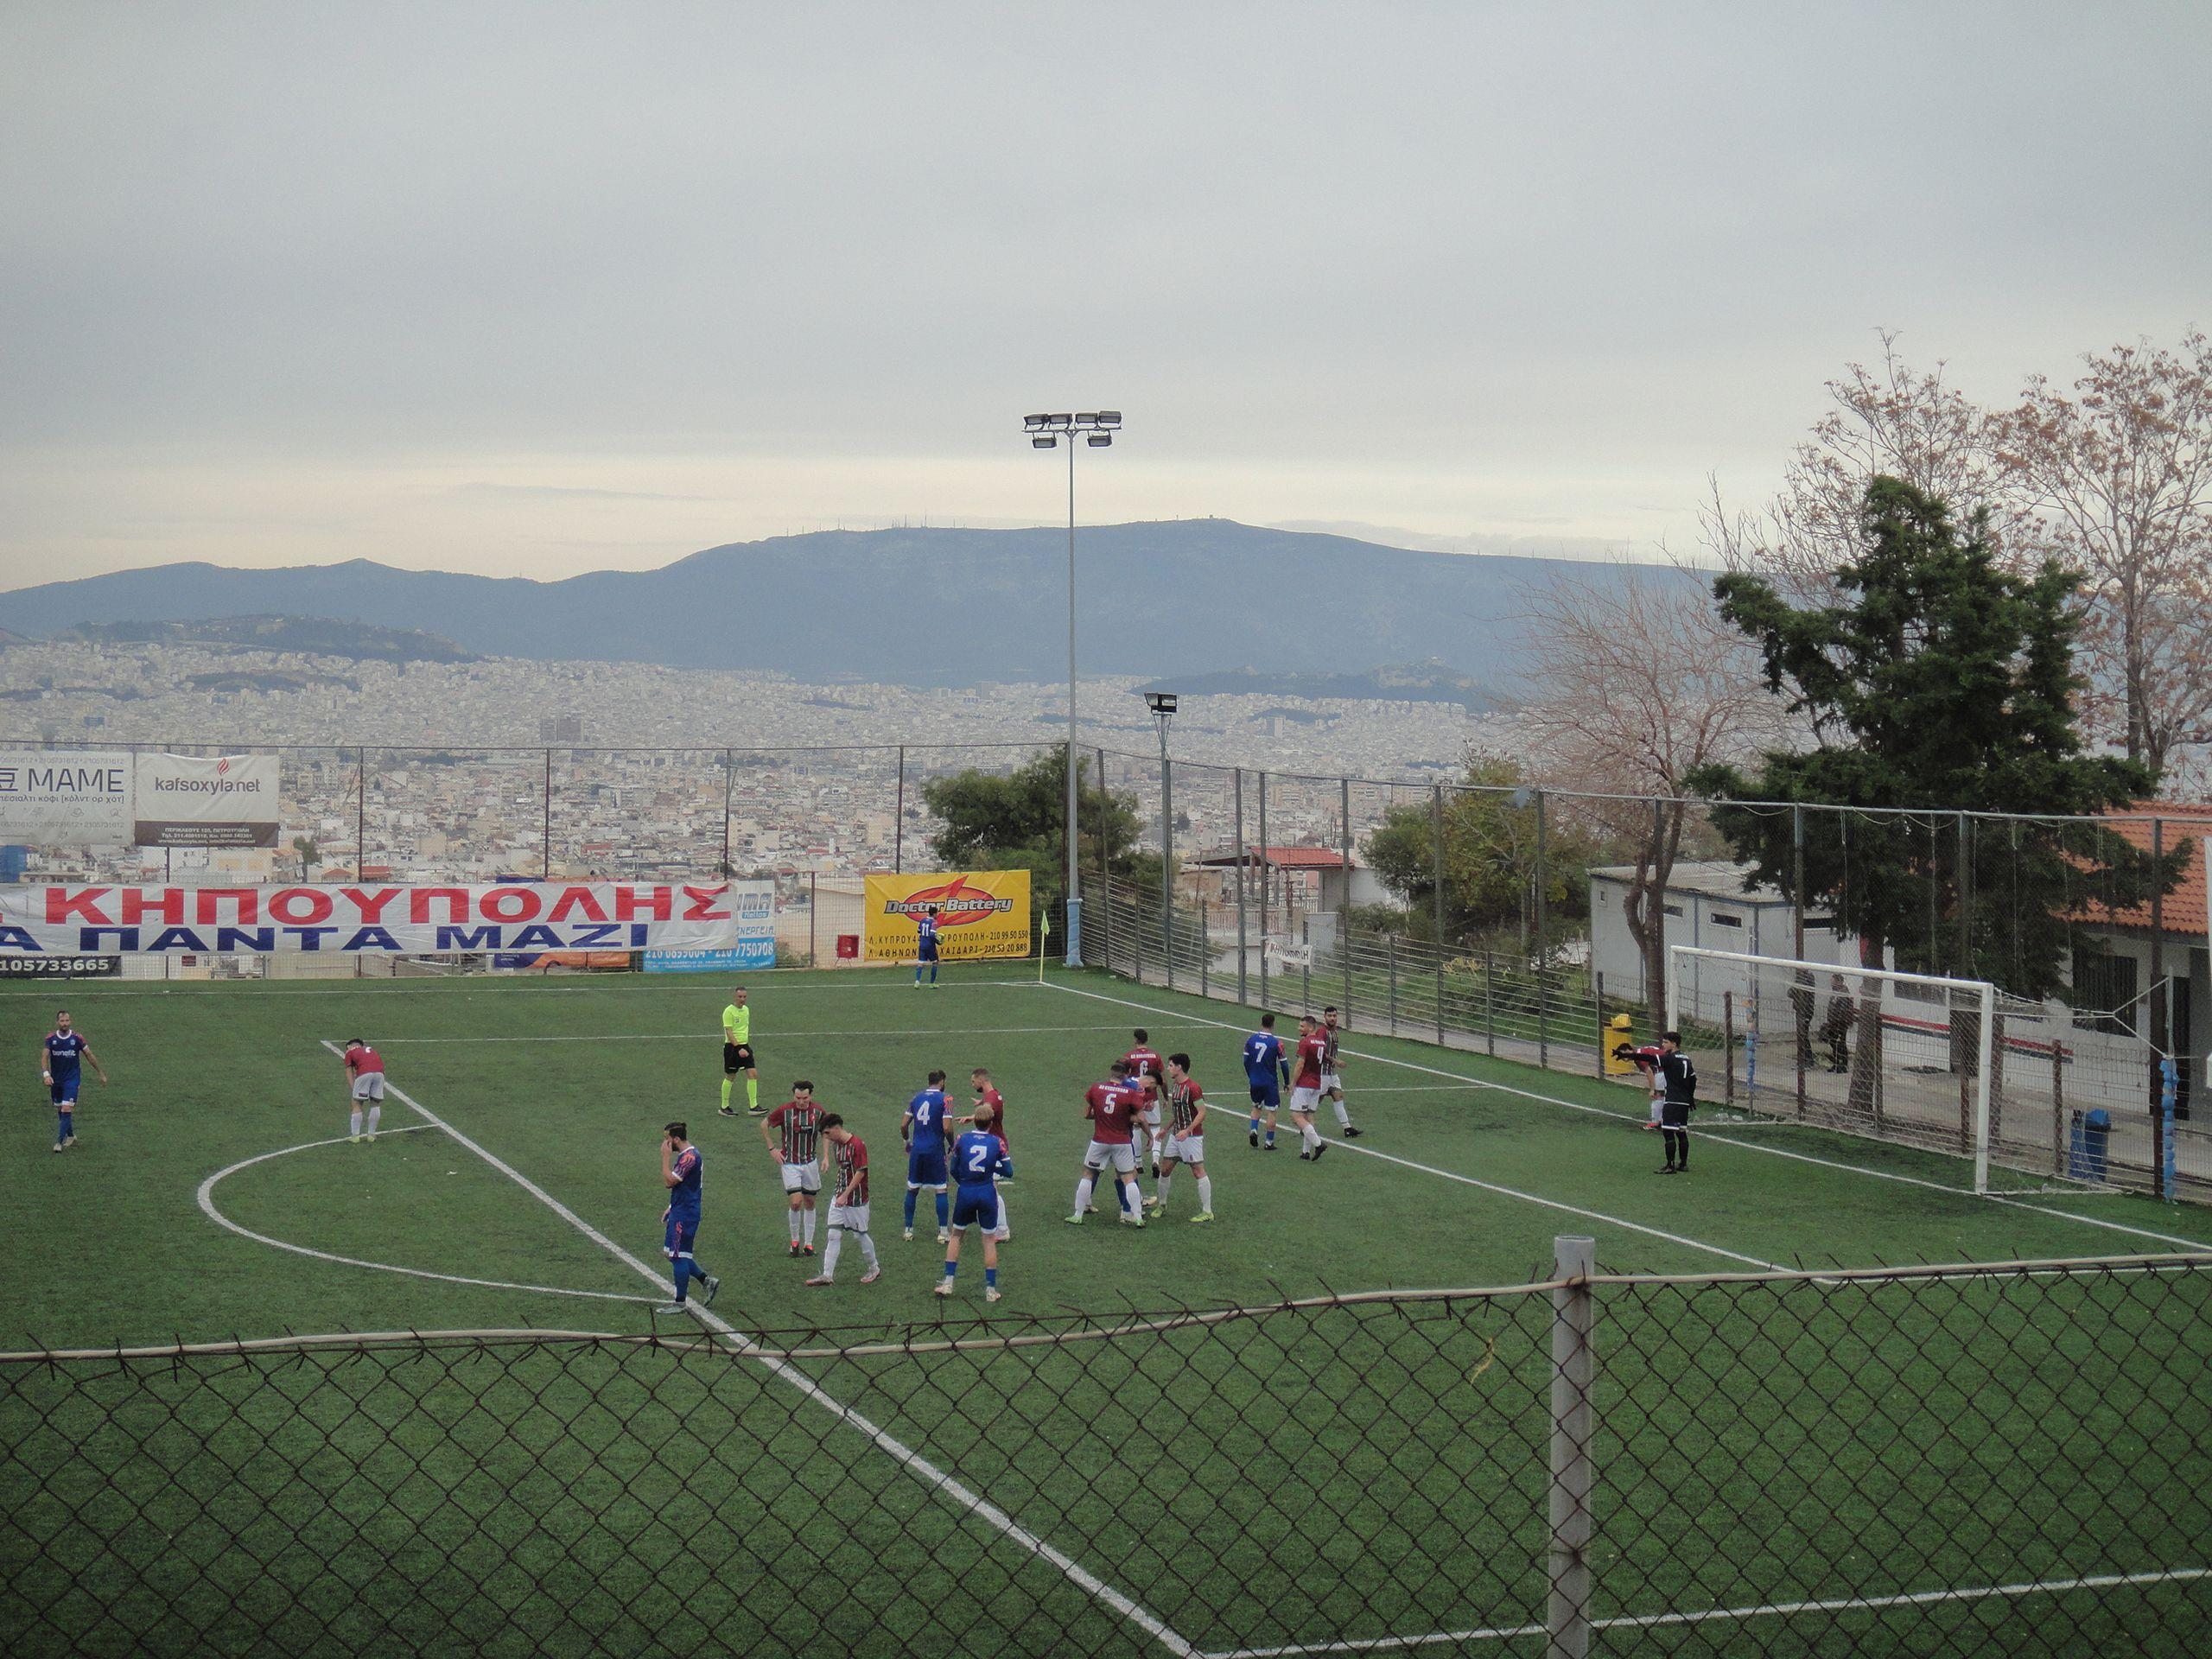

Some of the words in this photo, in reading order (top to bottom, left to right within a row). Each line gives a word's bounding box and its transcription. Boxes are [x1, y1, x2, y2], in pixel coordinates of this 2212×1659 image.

[29, 768, 124, 792] MAME
[156, 777, 260, 795] kafsoxyla.net
[46, 885, 731, 925] ΚΗΠΟΥΠΟΛΗΣ
[884, 900, 944, 913] Doctor
[945, 898, 1014, 912] Battery
[79, 926, 404, 951] ΠΑΝΤΑ
[436, 923, 648, 950] ΜΑΖΙ
[921, 923, 930, 937] 11
[1255, 1042, 1268, 1063] 7
[1682, 1060, 1688, 1078] 1
[917, 1101, 931, 1125] 4
[1103, 1093, 1117, 1114] 5
[969, 1145, 988, 1173] 2
